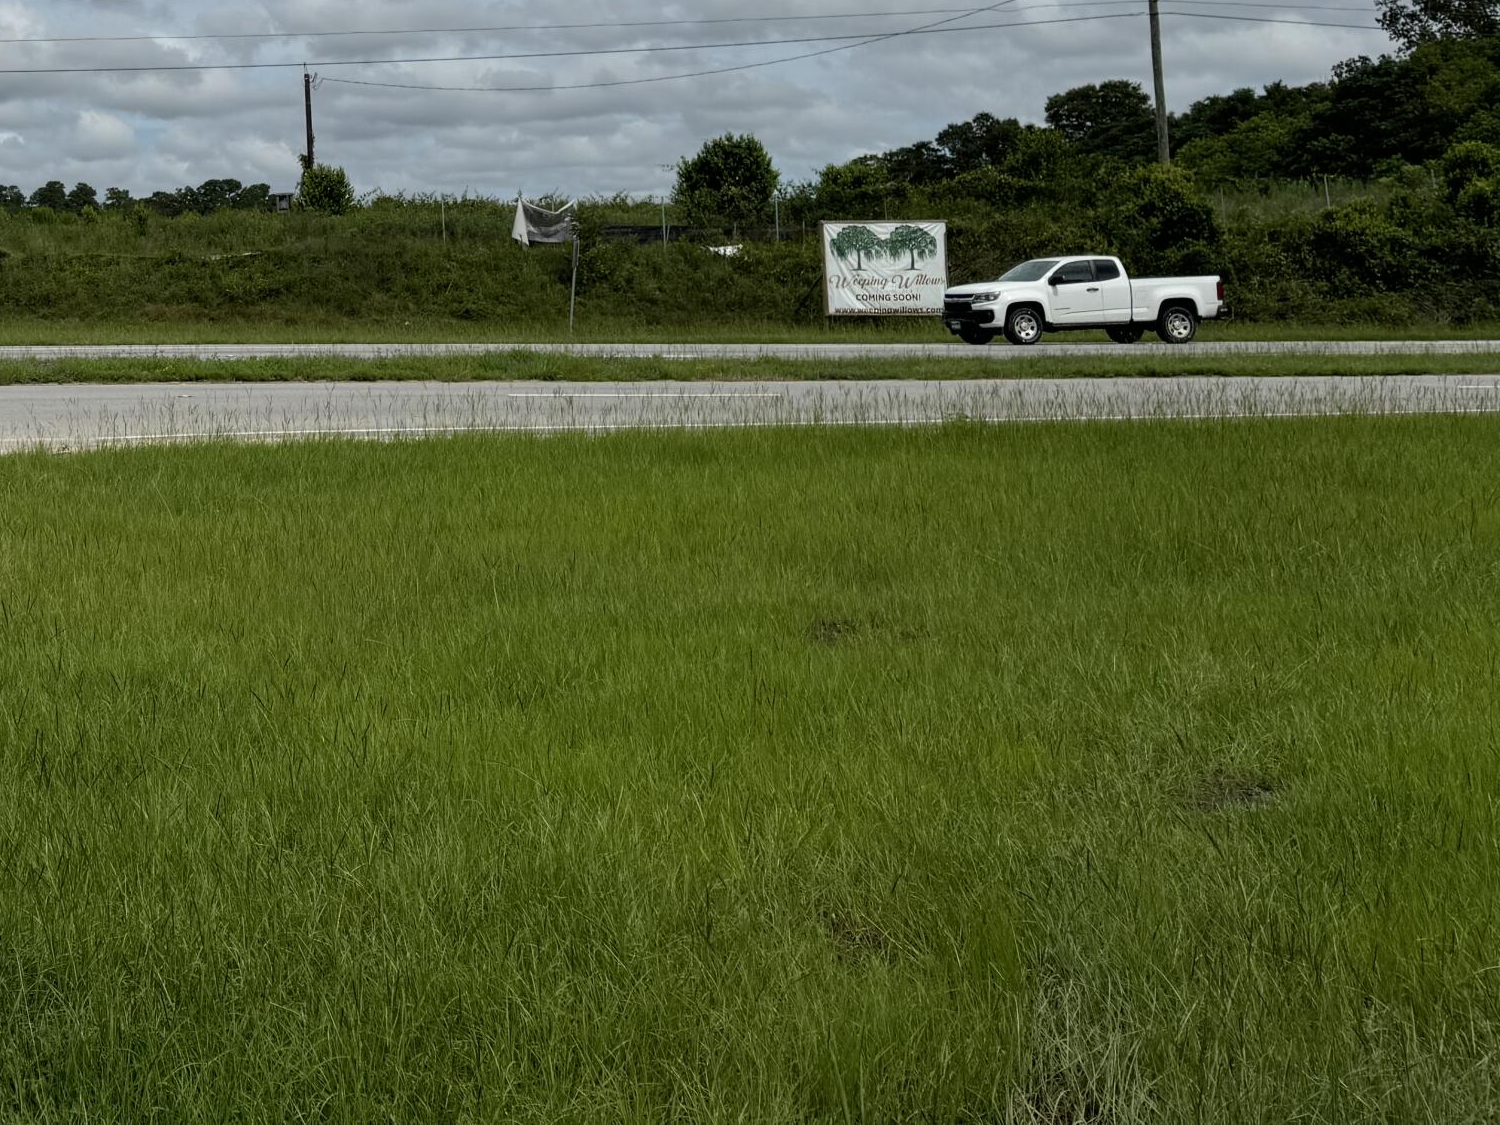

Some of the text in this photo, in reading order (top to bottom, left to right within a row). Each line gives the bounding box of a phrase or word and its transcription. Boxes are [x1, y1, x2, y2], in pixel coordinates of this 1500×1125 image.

[829, 274, 946, 290] Weeping Willows
[856, 293, 921, 302] COMING SOON!
